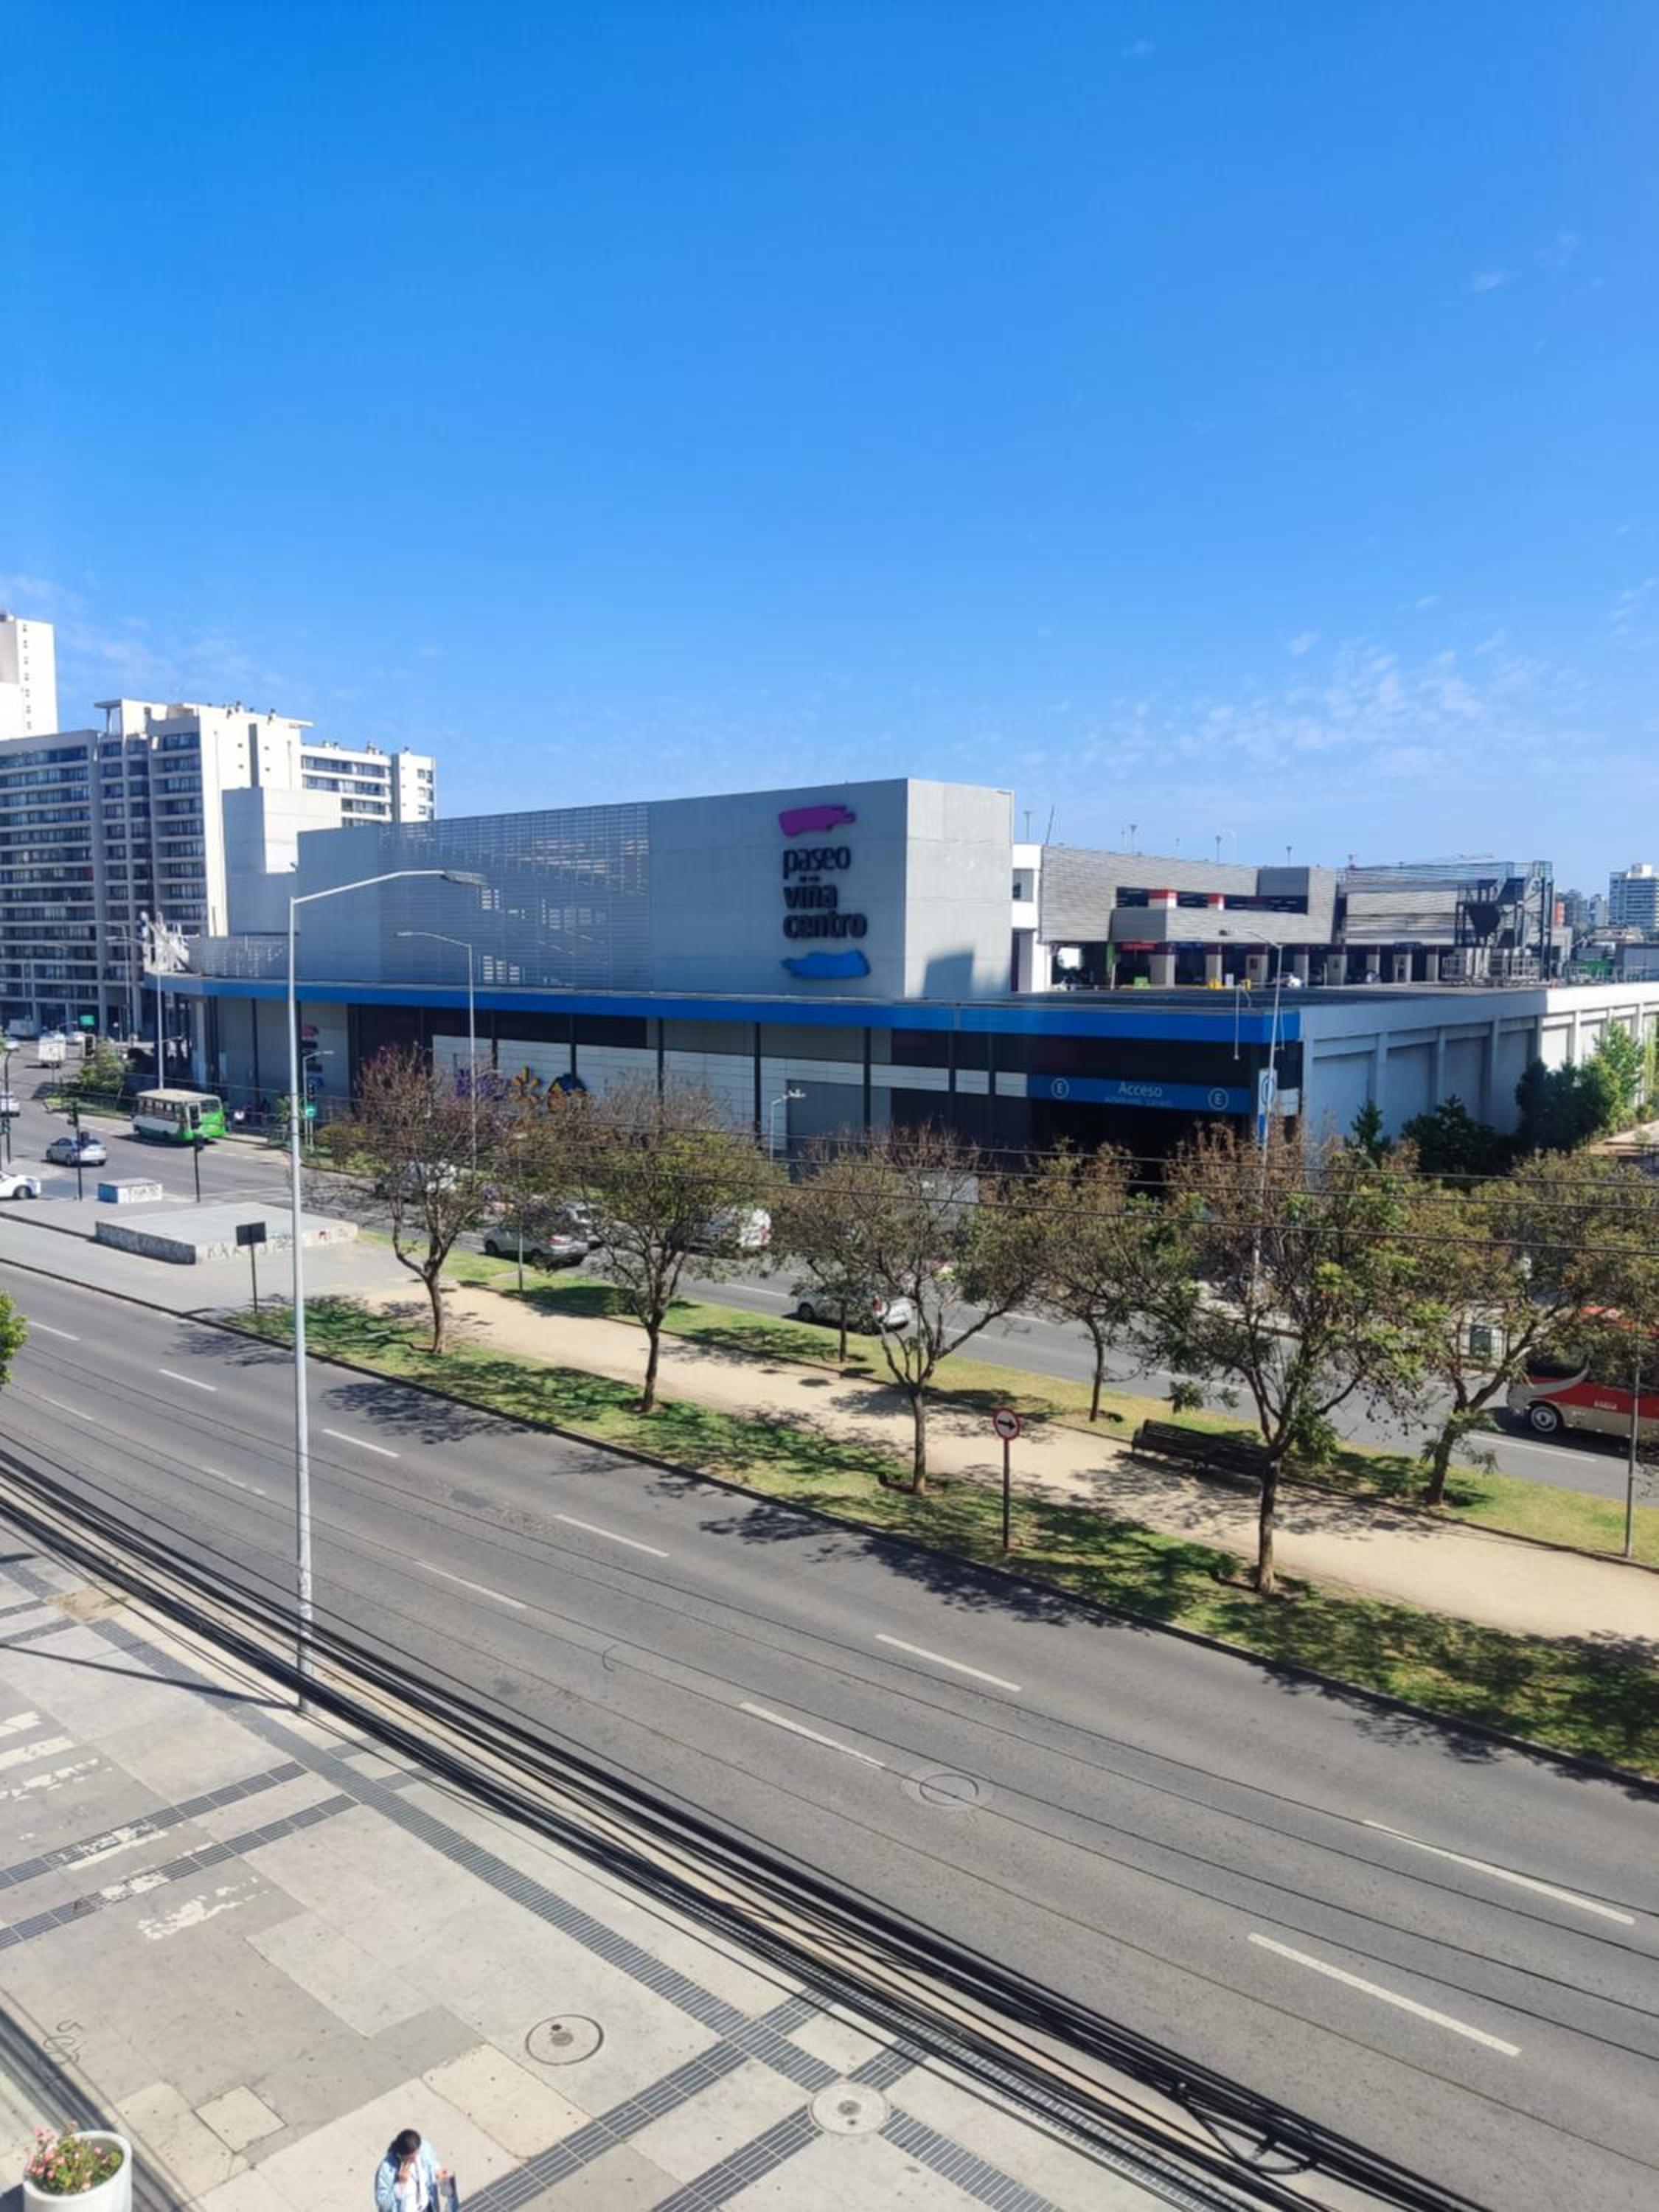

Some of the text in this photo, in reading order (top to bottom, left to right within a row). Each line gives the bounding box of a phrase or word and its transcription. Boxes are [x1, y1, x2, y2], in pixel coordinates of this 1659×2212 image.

[783, 846, 852, 880] paseo
[783, 875, 838, 909] viña
[783, 911, 868, 939] centro
[1118, 1080, 1163, 1098] Acceso
